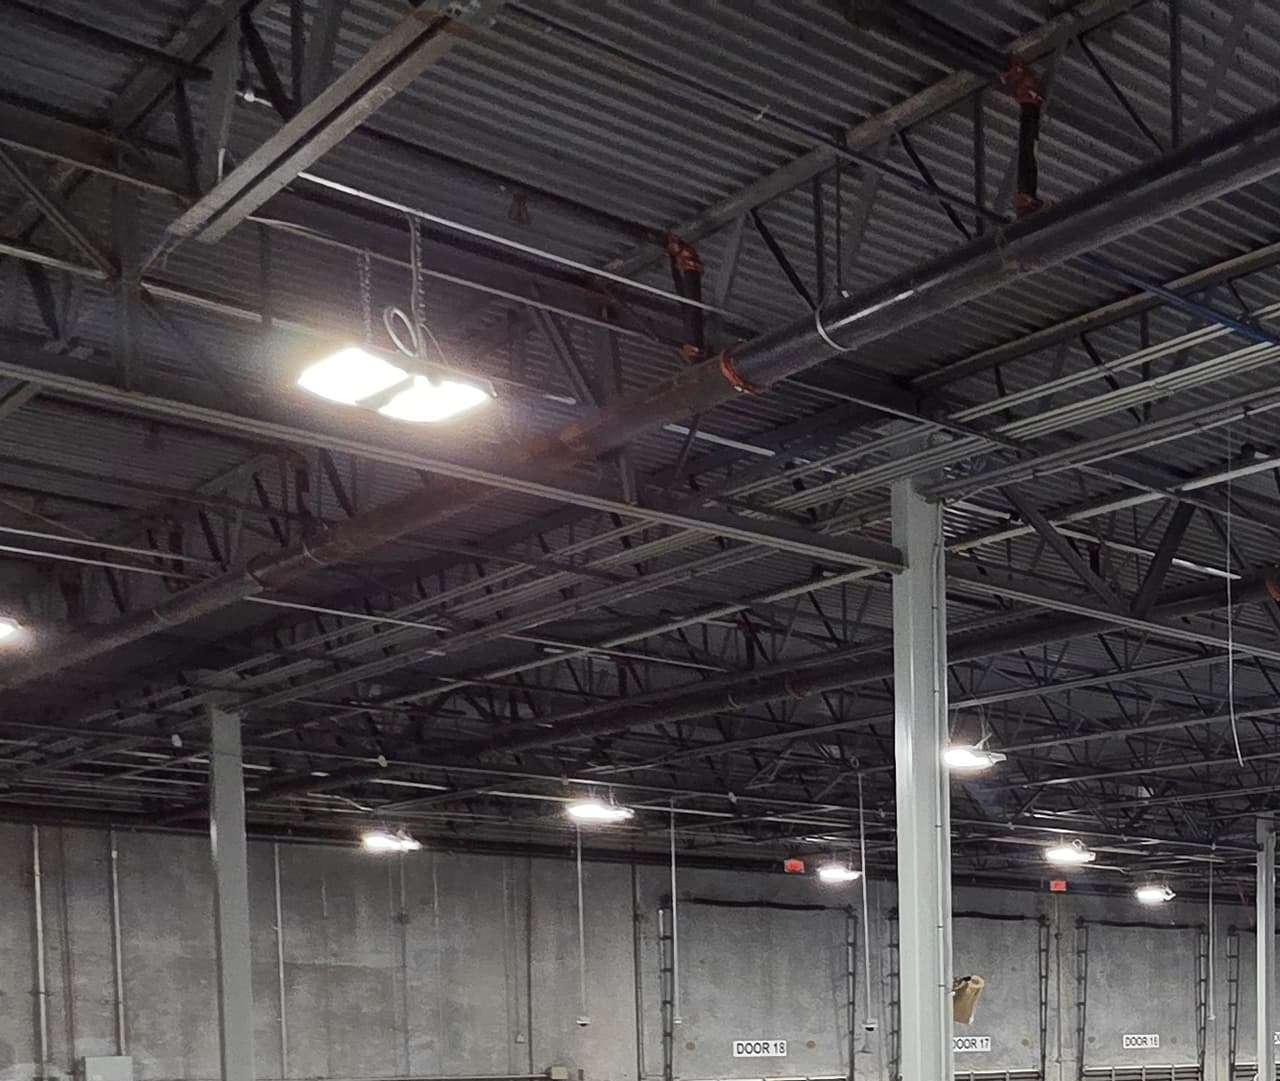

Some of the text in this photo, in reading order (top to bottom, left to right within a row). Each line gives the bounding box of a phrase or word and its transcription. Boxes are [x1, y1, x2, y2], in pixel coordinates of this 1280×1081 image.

[980, 1038, 989, 1048] 17
[1125, 1036, 1148, 1046] DOOR
[737, 1042, 785, 1054] DOOR 18
